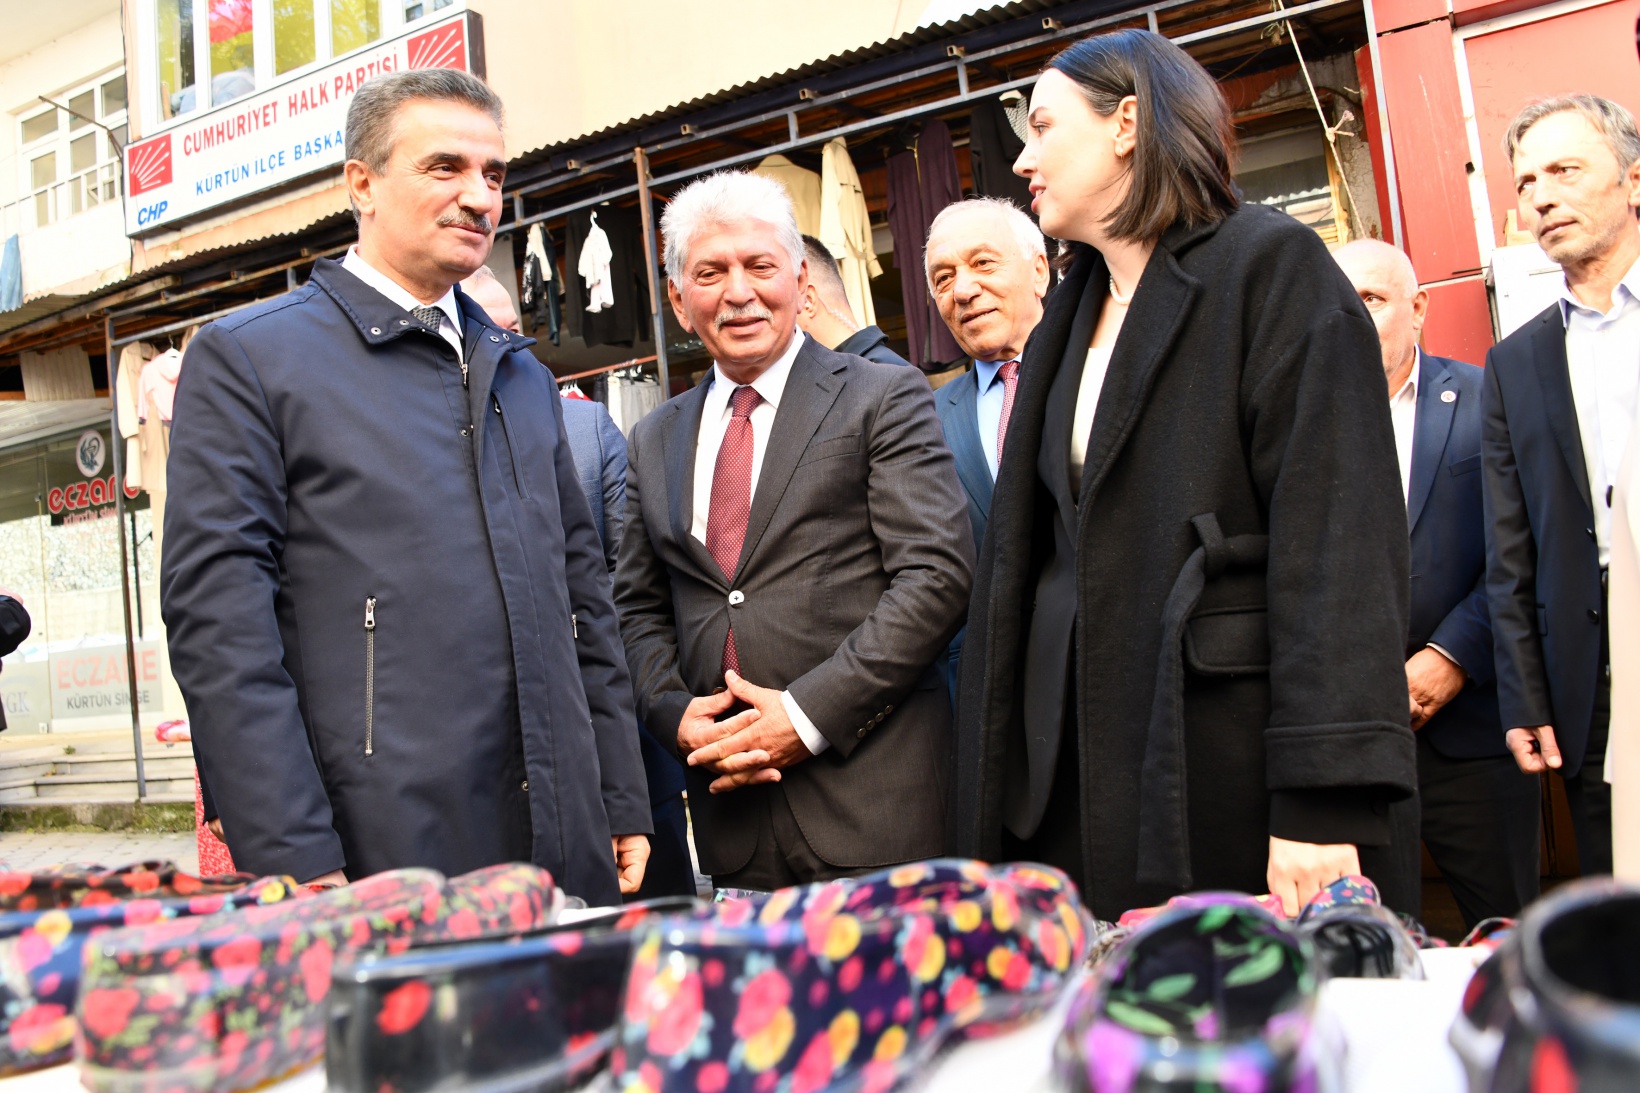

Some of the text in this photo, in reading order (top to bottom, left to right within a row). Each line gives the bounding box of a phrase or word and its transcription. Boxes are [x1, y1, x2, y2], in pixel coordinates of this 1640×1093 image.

[184, 101, 279, 156] CUMHURİYET
[289, 81, 329, 118] HALK
[196, 130, 343, 196] KÜRTÜN İLÇE BAŞKA
[137, 200, 168, 226] CHP
[67, 692, 112, 710] KÜRTÜN
